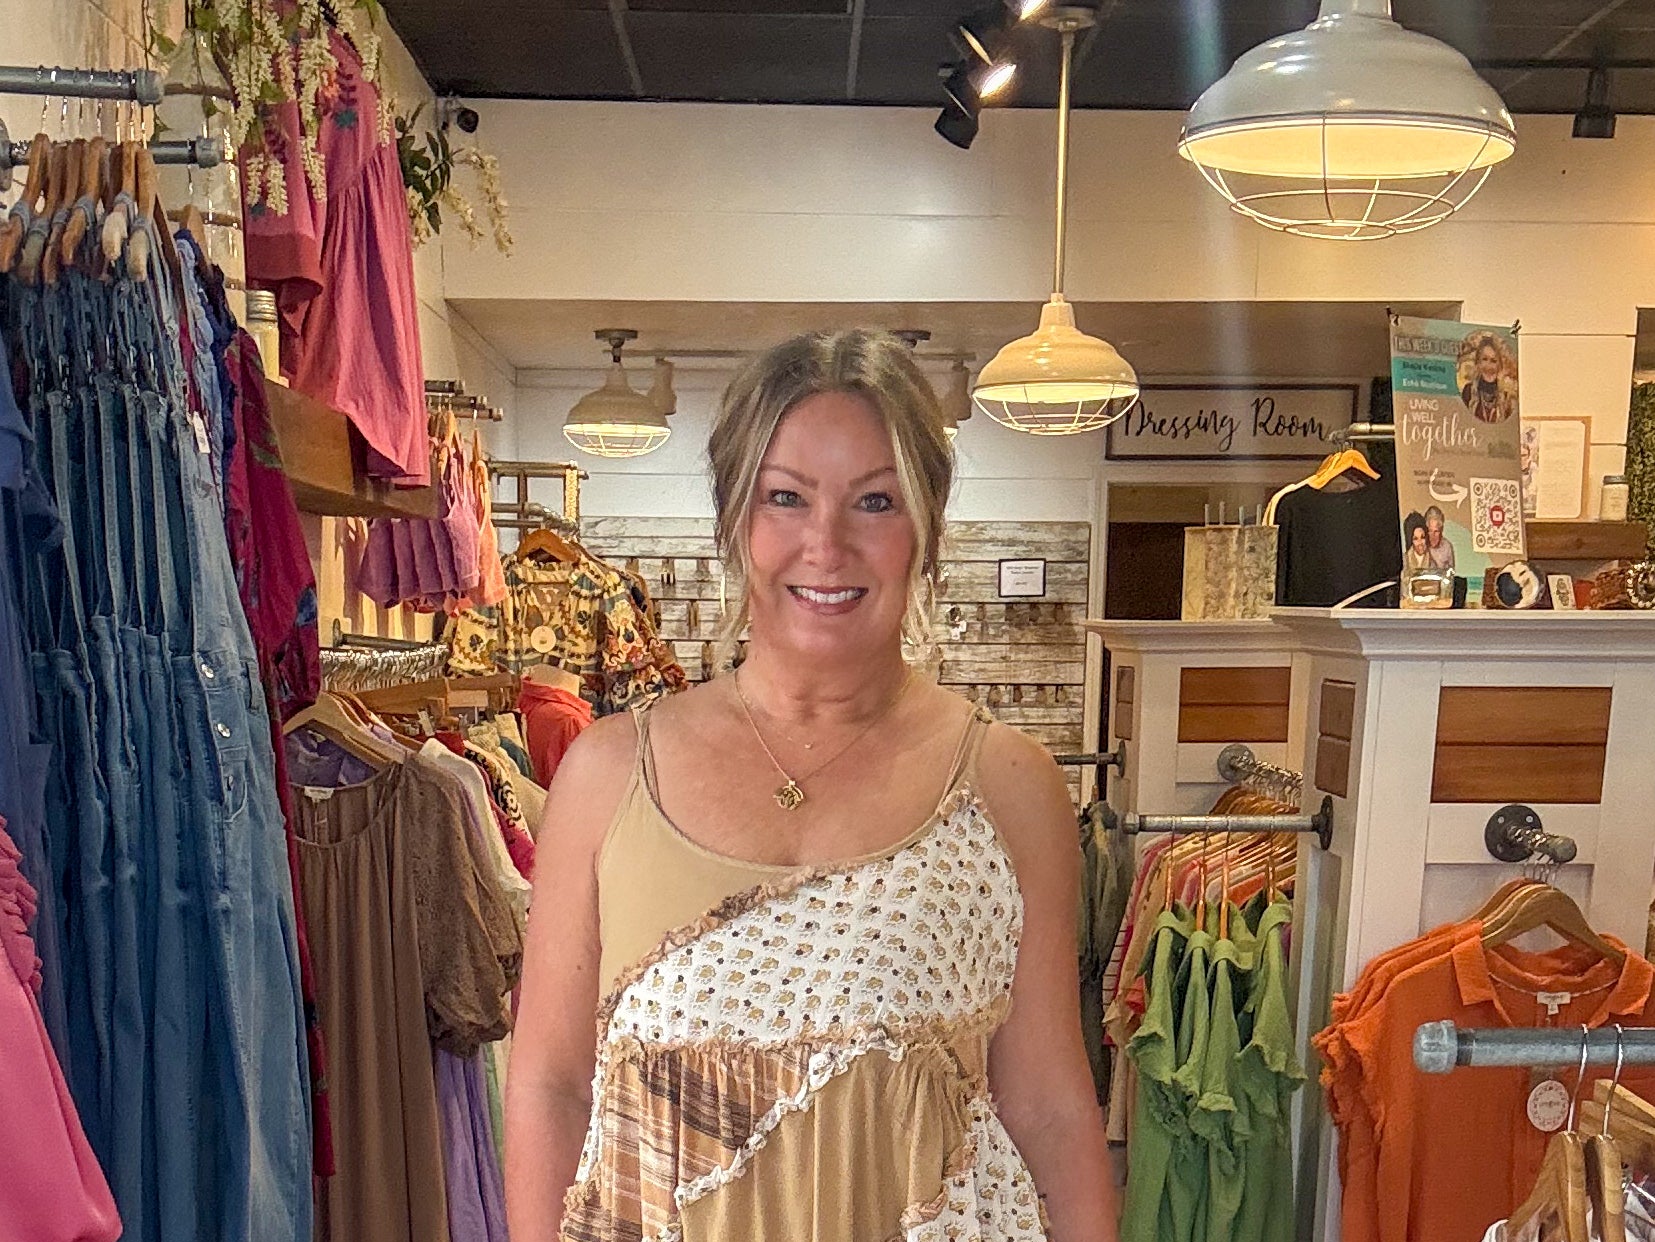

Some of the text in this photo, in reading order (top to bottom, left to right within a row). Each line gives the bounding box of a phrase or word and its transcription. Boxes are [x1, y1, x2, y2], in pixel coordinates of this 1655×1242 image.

[1409, 399, 1439, 411] LIVING
[1411, 411, 1436, 424] WELL
[1118, 397, 1329, 452] Dressing Room
[1402, 413, 1478, 461] together
